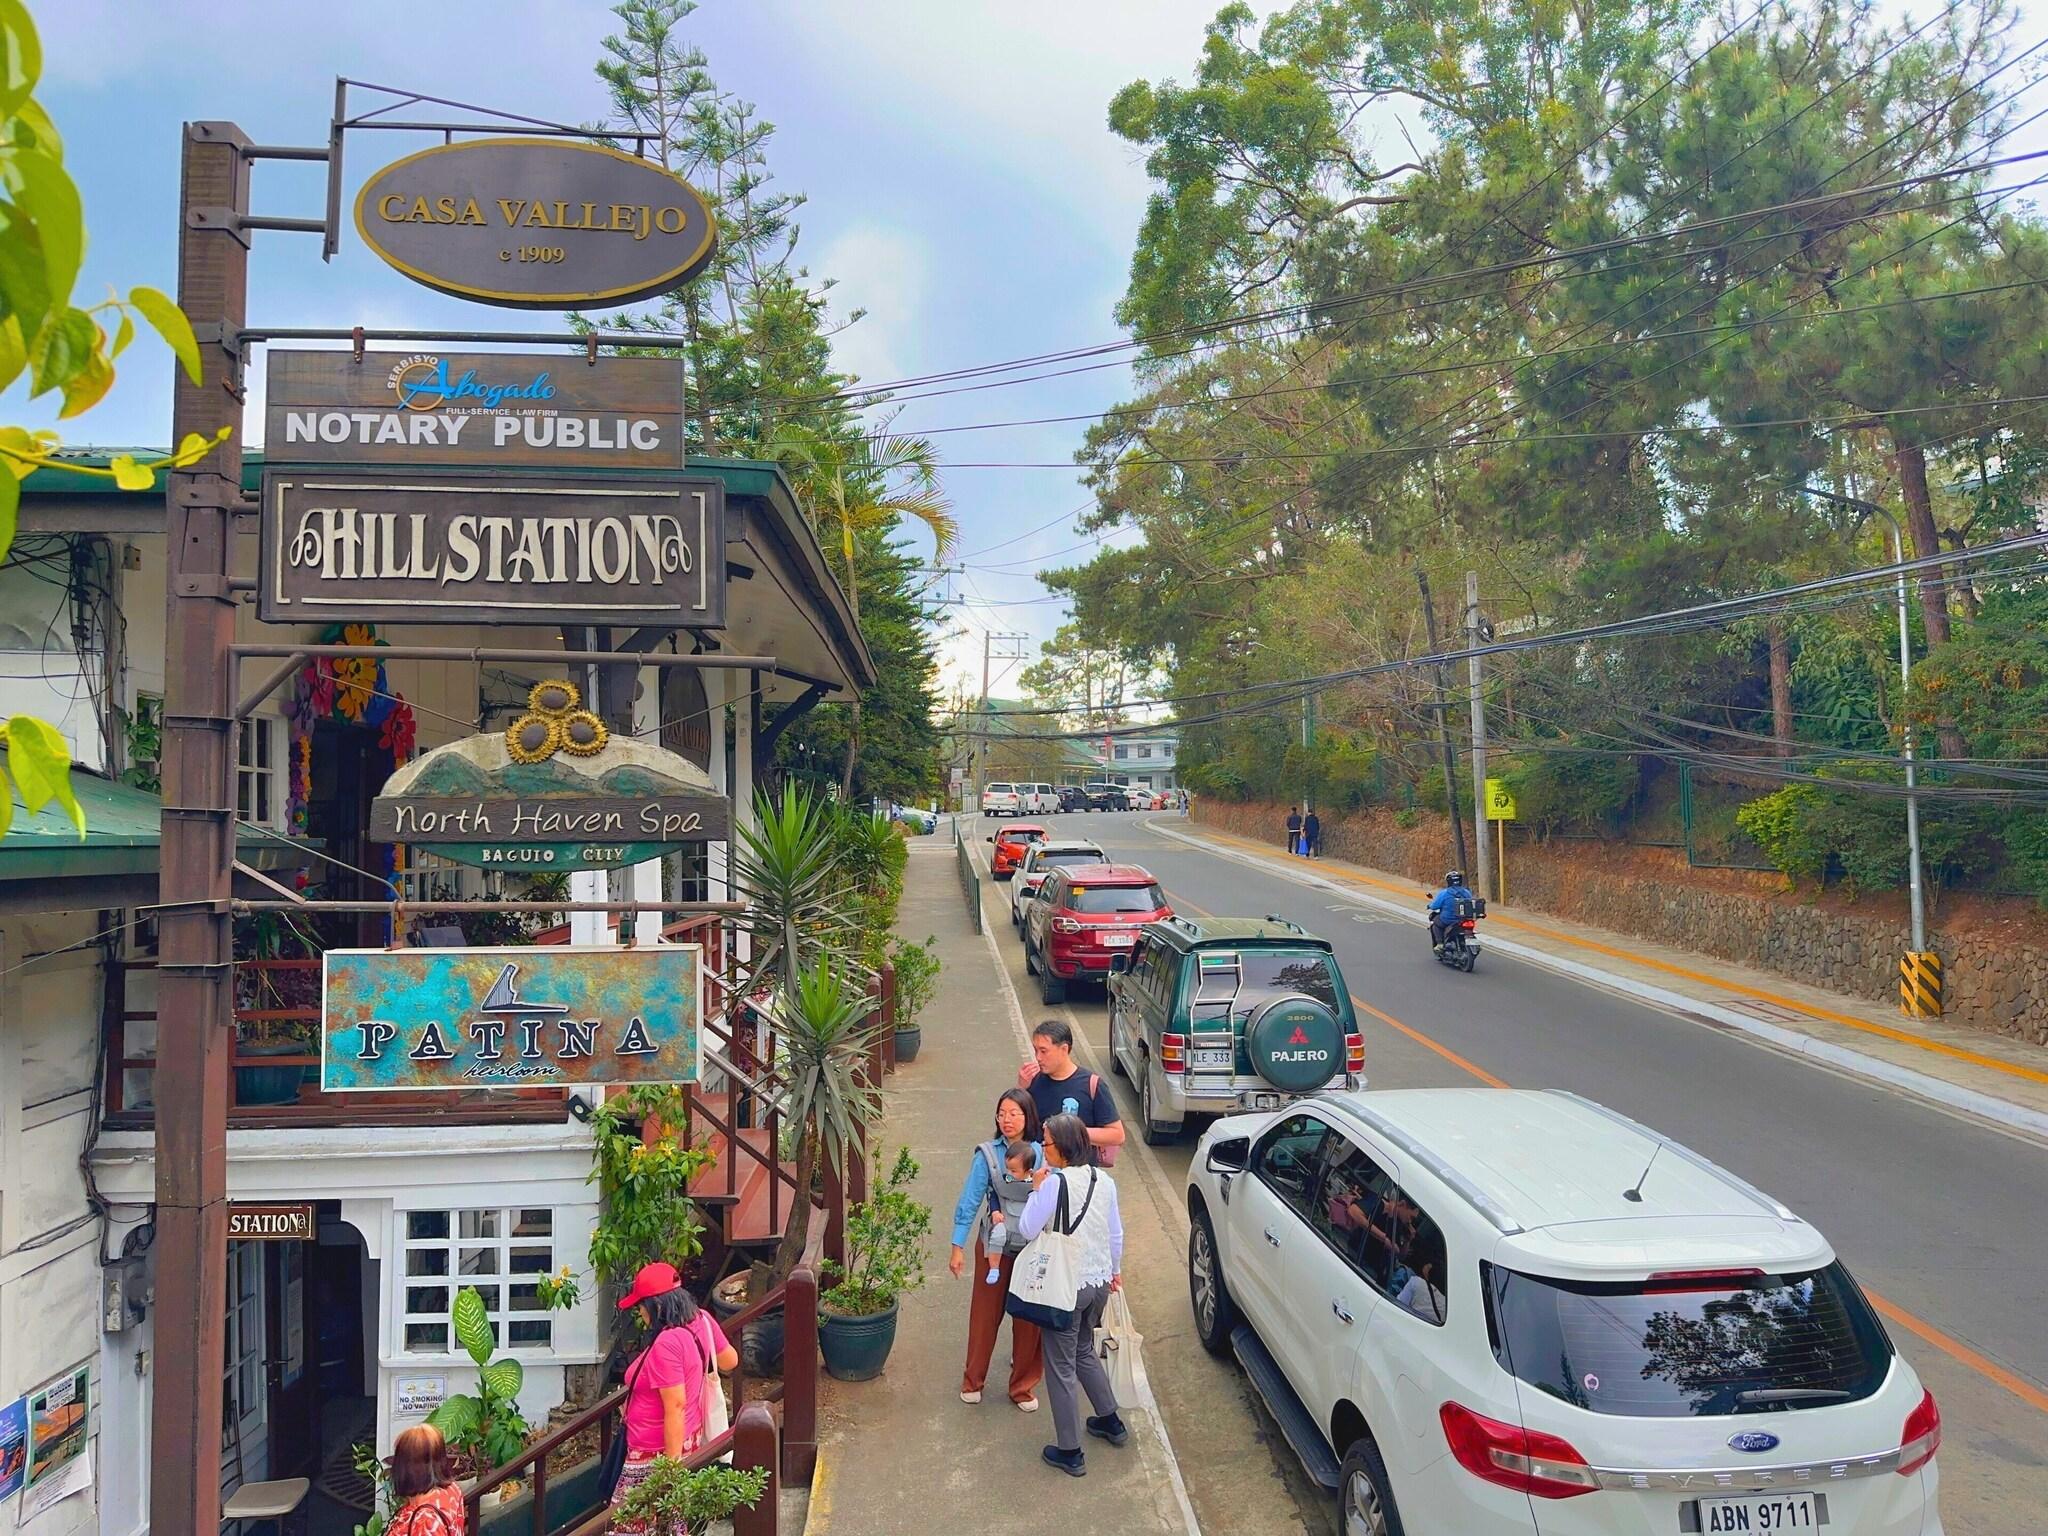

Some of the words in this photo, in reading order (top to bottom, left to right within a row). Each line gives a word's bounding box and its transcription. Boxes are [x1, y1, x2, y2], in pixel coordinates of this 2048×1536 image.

[377, 193, 487, 225] CASA
[496, 199, 688, 241] VALLEJO
[518, 246, 565, 264] 1909
[387, 354, 439, 389] SERBISYO
[397, 358, 557, 411] Abogado
[446, 407, 511, 416] FULL-SERVICE
[537, 409, 559, 417] FIRM
[285, 412, 471, 446] NOTARY
[494, 416, 661, 450] PUBLIC
[394, 802, 492, 834] North
[511, 803, 625, 835] Haven
[639, 802, 704, 841] Spa
[482, 848, 555, 862] BAGUIO
[582, 847, 626, 862] CITY
[355, 1016, 659, 1060] PATINA
[1213, 1052, 1230, 1063] 333
[1271, 1049, 1328, 1062] PAJERO
[462, 1060, 562, 1079] heirloom
[229, 1212, 307, 1233] STATION
[411, 1395, 443, 1403] SMOKING
[1741, 1433, 1771, 1449] Ford
[1628, 1459, 1880, 1489] EVEREST
[1710, 1504, 1750, 1532] ABN
[1758, 1500, 1811, 1529] 9711
